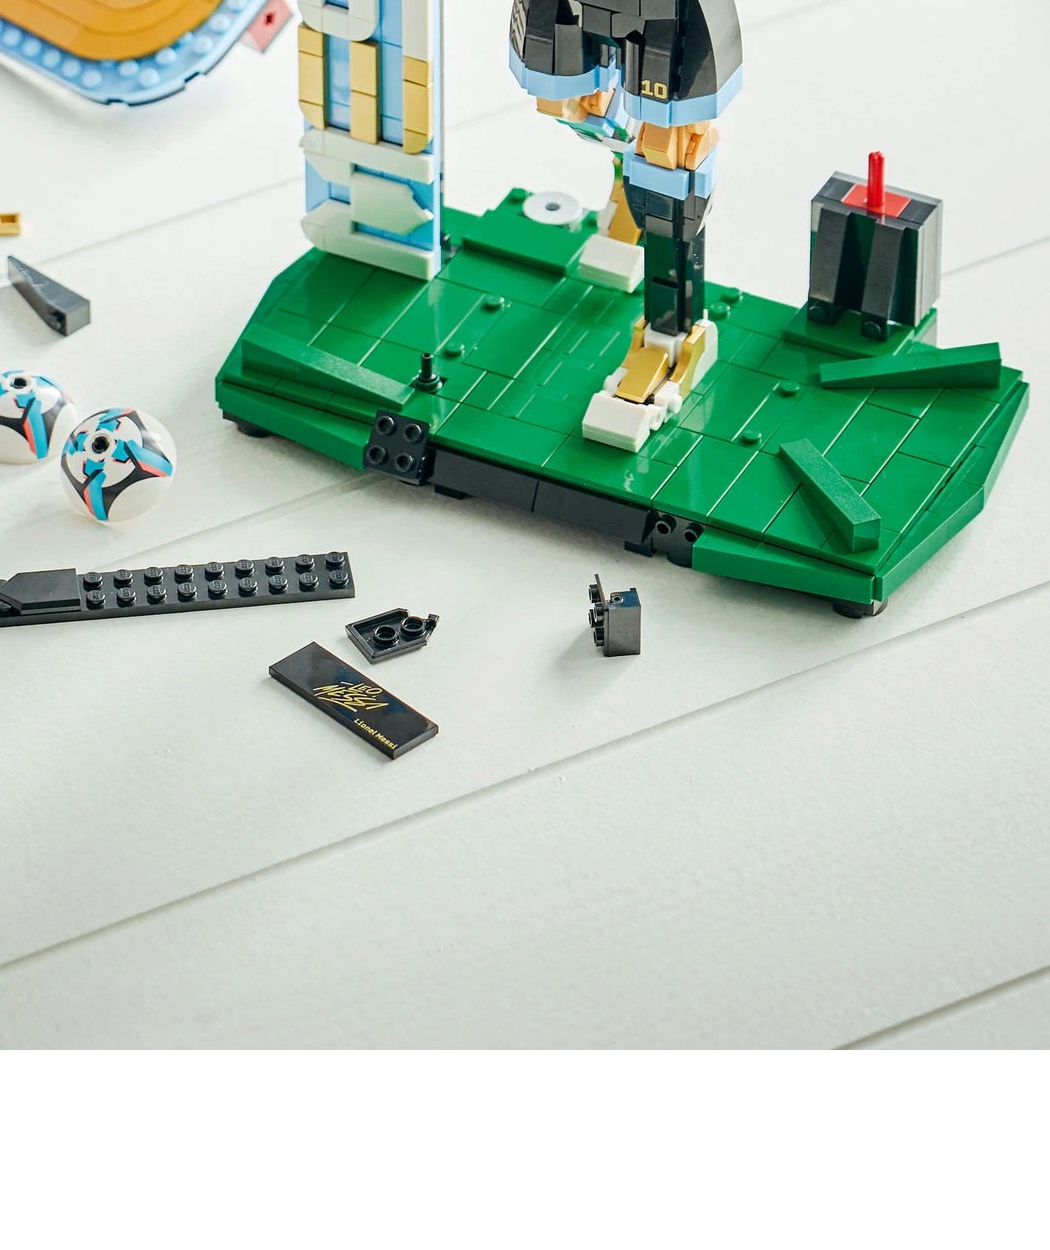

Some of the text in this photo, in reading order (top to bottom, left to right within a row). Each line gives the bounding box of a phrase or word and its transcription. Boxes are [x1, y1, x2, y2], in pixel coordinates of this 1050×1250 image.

[640, 79, 668, 100] 10
[353, 718, 399, 750] Lionel Messi
